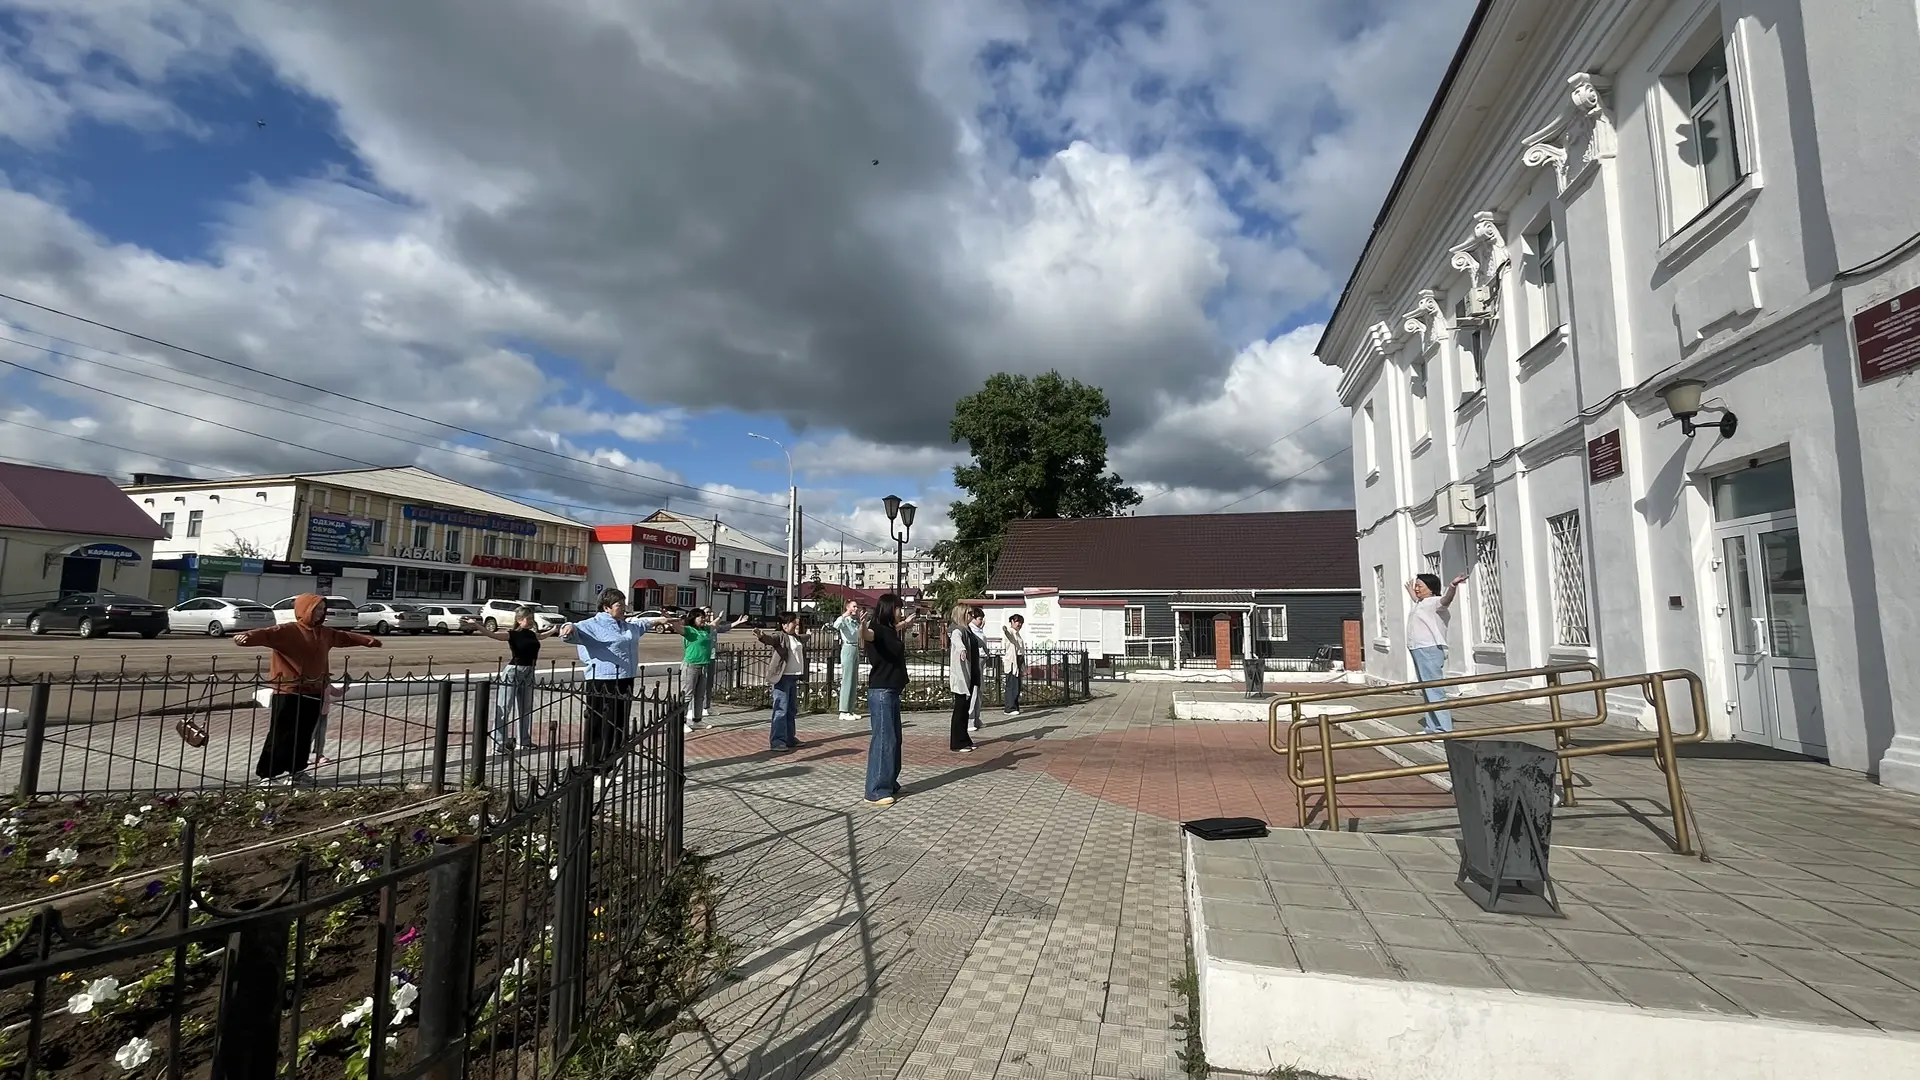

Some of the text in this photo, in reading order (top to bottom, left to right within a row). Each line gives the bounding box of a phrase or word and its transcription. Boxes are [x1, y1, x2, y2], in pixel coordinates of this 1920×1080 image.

[312, 518, 346, 528] ОДЕЖДА
[311, 526, 337, 534] ОБУВЬ
[665, 534, 688, 547] GOYO
[87, 548, 133, 558] КАРАНДАШ
[393, 545, 442, 561] ТАБАК
